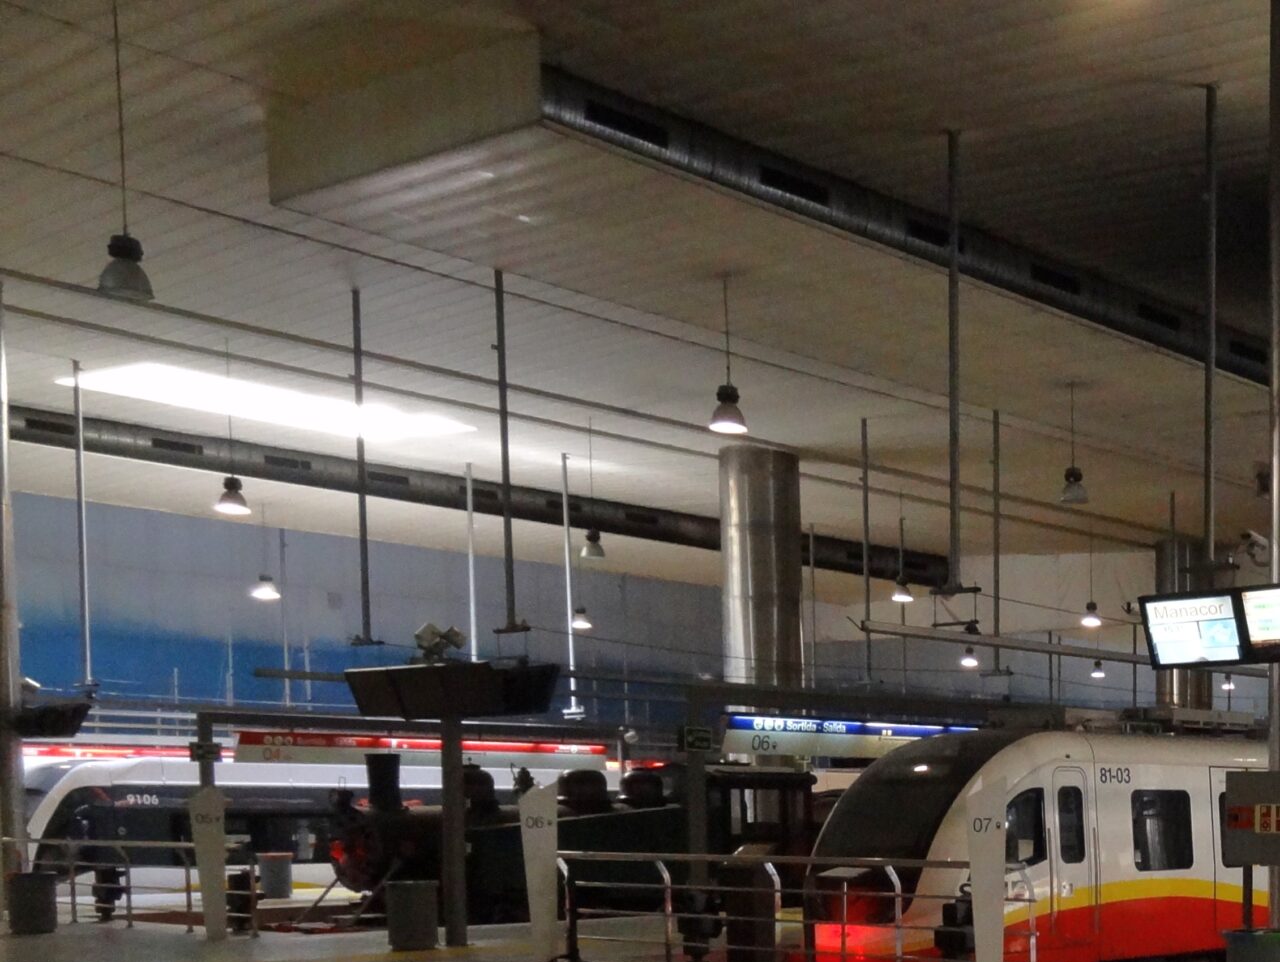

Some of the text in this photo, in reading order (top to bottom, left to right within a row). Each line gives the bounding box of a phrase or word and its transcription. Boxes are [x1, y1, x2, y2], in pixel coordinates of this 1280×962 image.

[1153, 602, 1225, 619] Manacor
[751, 734, 770, 751] 06
[1100, 767, 1131, 784] 81-03
[126, 794, 159, 806] 9106
[525, 815, 545, 829] 06
[973, 817, 992, 833] 07
